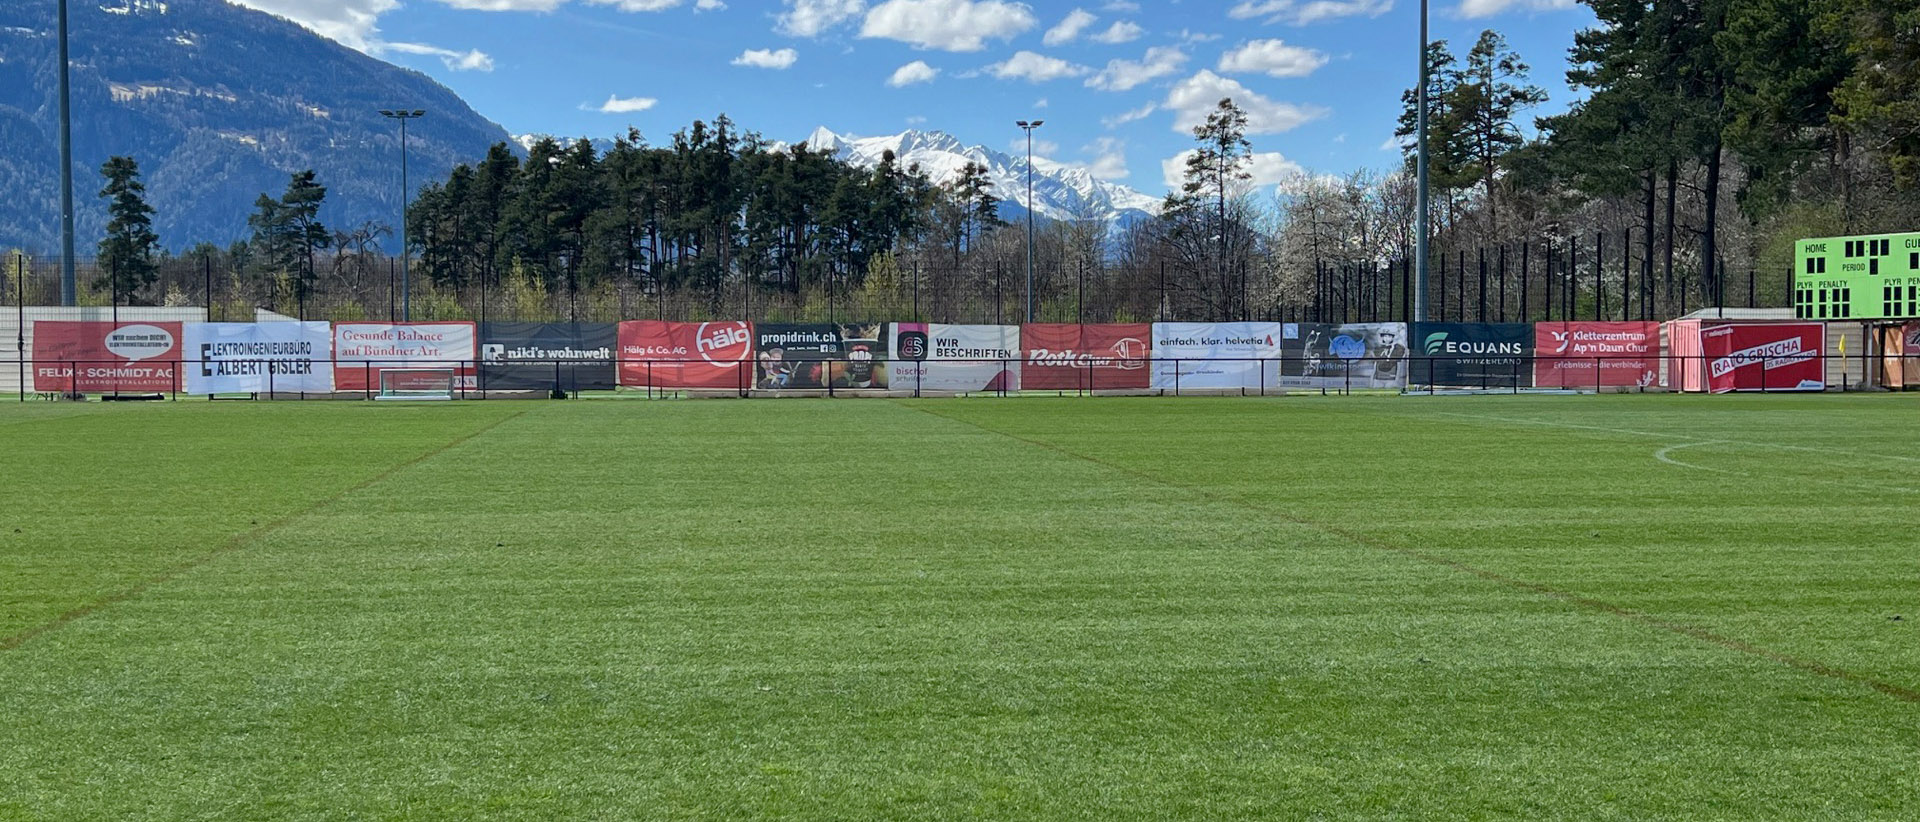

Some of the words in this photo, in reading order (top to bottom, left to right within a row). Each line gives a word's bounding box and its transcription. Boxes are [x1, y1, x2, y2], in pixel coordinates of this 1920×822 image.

[1805, 244, 1826, 253] HOME
[1818, 280, 1848, 288] PENALTY
[1884, 278, 1902, 286] PLYR
[342, 330, 394, 341] Gesunde
[398, 330, 443, 341] Balance
[762, 332, 836, 346] propidrink.ch
[1574, 331, 1646, 340] Kletterzentrum
[936, 338, 958, 348] WIR
[1160, 338, 1198, 346] einfach.
[1226, 336, 1263, 345] helvetia
[342, 345, 360, 356] auf
[364, 345, 414, 356] Bündner
[417, 346, 442, 356] Art.
[624, 346, 645, 355] Hälg
[656, 346, 670, 354] Co.
[672, 346, 688, 354] AG
[1446, 341, 1522, 354] EQUANS
[1600, 344, 1624, 352] Daun
[1626, 343, 1648, 352] Chur
[1748, 340, 1799, 362] GRISCHA
[508, 347, 544, 358] niki's
[547, 347, 610, 359] wohnwelt
[936, 348, 1012, 358] BESCHRIFTEN
[1028, 348, 1076, 366] Roth
[1077, 354, 1114, 366] Chur
[217, 359, 264, 376] ALBERT
[269, 358, 312, 374] GISLER
[38, 368, 74, 378] FELIX
[77, 368, 84, 376] +
[87, 368, 152, 378] SCHMIDT
[155, 368, 174, 378] AG
